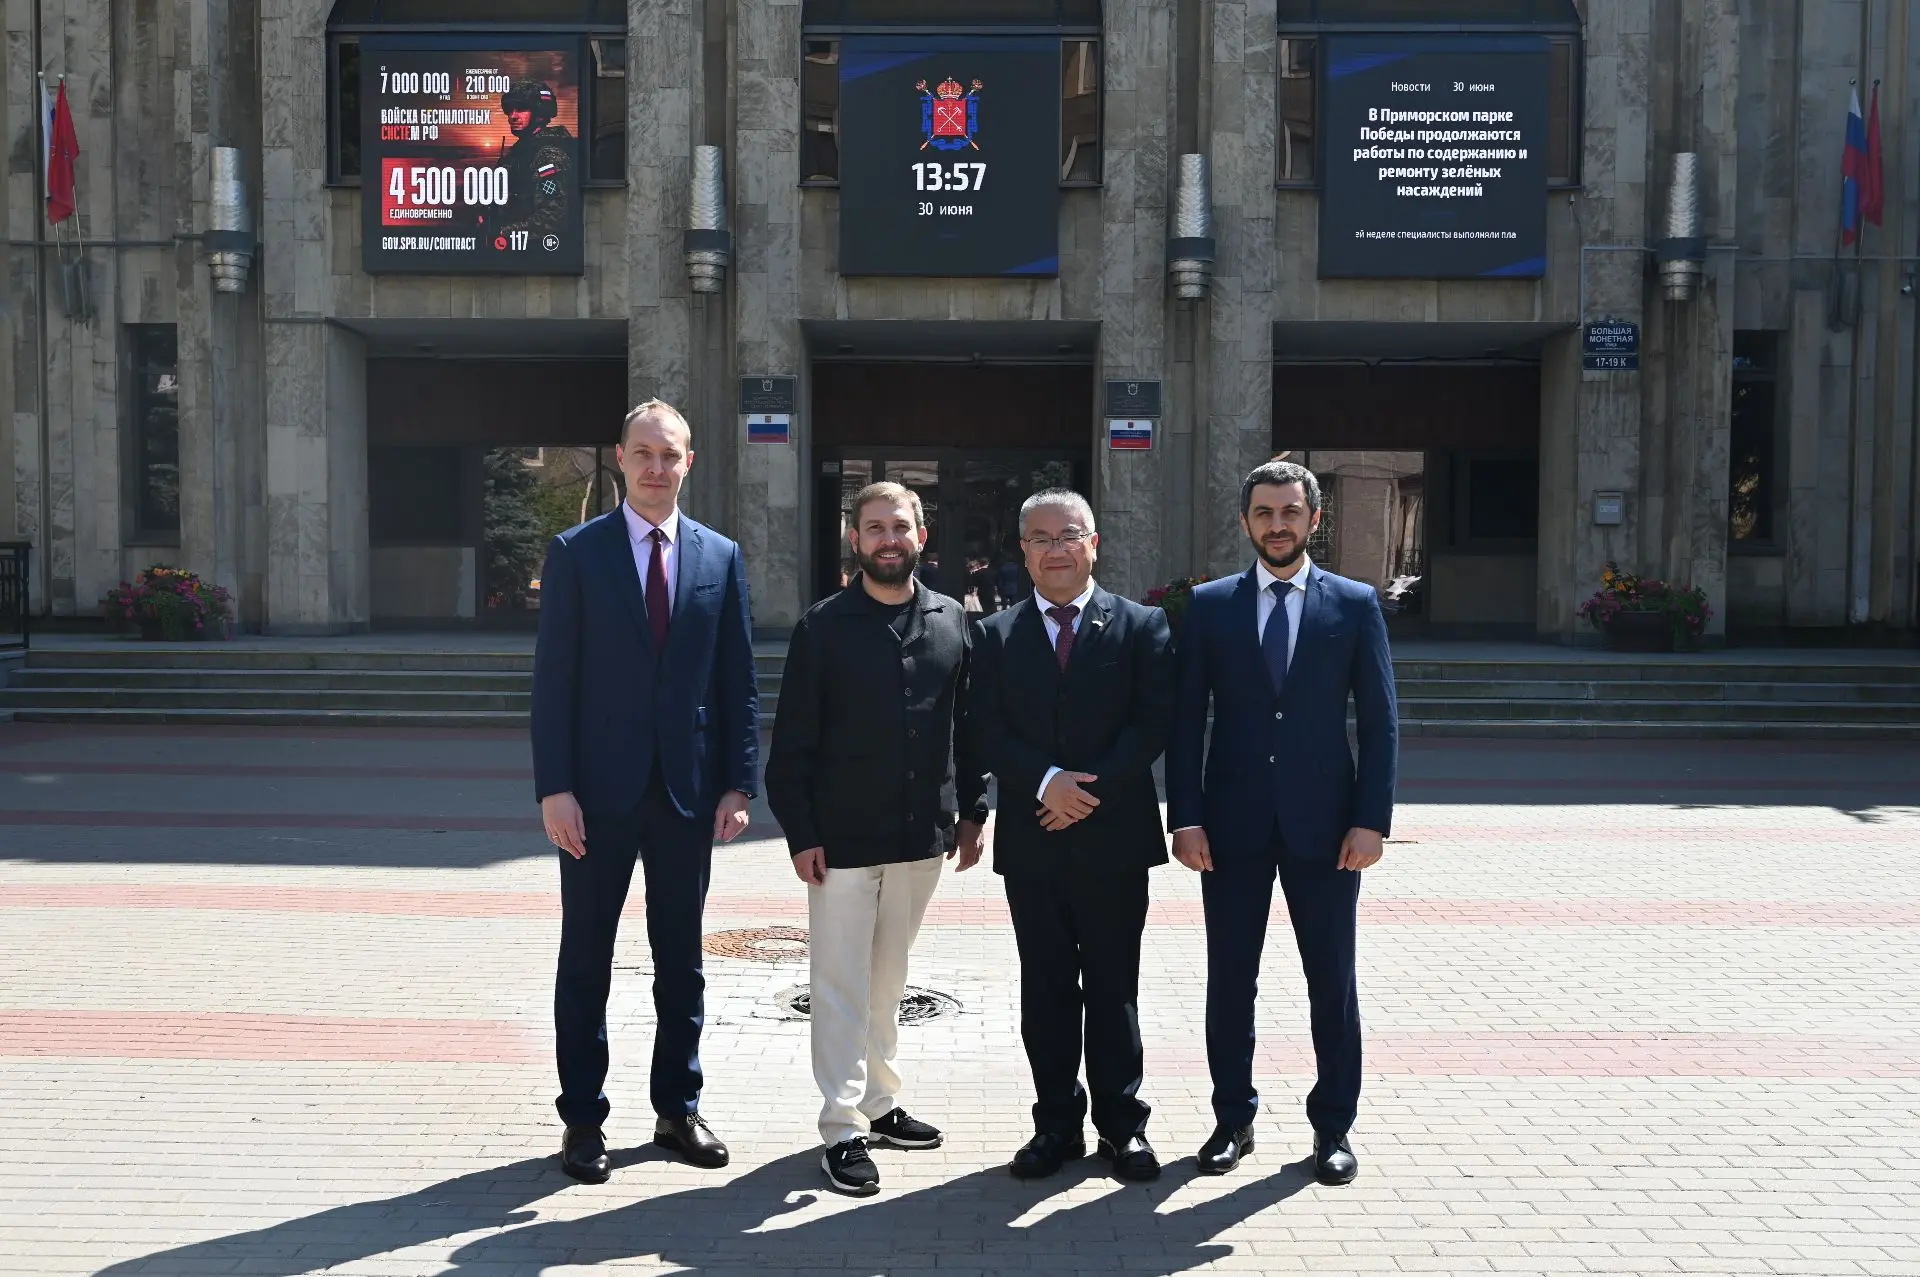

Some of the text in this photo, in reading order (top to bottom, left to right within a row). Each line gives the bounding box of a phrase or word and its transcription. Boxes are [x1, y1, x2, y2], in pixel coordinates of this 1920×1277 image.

[380, 72, 450, 94] 7 000 000
[466, 76, 510, 93] 210 000
[1391, 82, 1494, 92] Новости 30 июня
[381, 107, 491, 124] ВОЙСКА БЕСПИЛОТНЫХ
[1368, 108, 1513, 124] В Приморском парке
[381, 125, 439, 140] СИСТЕМ РФ
[1360, 127, 1521, 143] Победы продолжаются
[1353, 145, 1528, 162] работы по содержанию и
[912, 162, 987, 191] 13:57
[1379, 165, 1501, 180] ремонту зелёных
[389, 167, 508, 205] 4 500 000
[1397, 183, 1483, 198] насаждений
[389, 209, 453, 219] ЕДИНОВРЕМЕННО
[918, 202, 973, 215] 30 июня
[510, 231, 528, 250] 117
[1366, 231, 1396, 240] неделе
[1397, 231, 1452, 240] специалисты
[382, 237, 476, 251] GOV.SPB.RU/CONTRACT
[1596, 358, 1626, 367] 17-19 К
